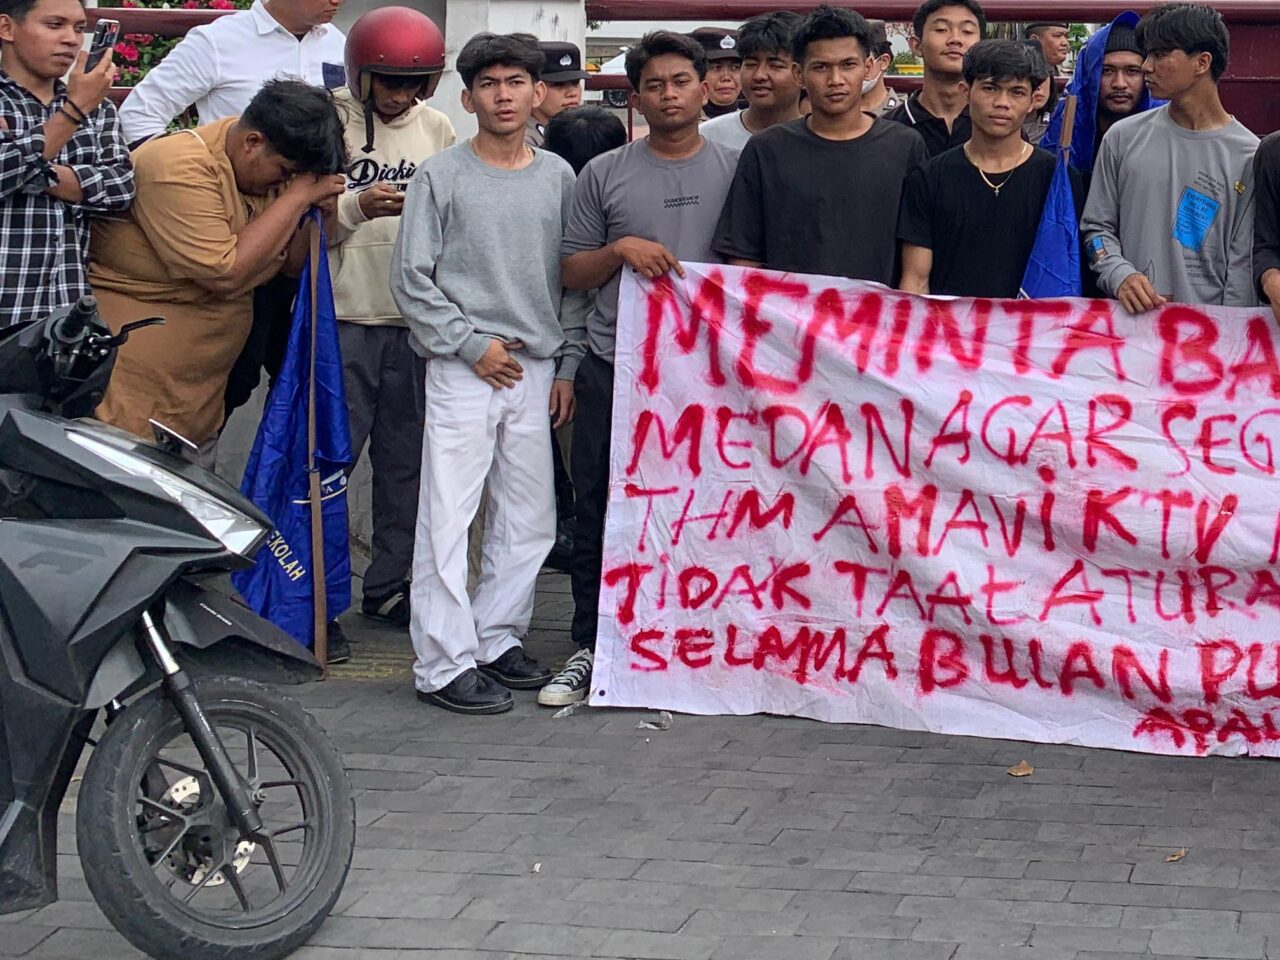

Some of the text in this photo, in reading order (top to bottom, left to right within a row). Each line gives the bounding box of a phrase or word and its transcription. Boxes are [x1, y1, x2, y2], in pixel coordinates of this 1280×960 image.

[637, 270, 1128, 395] MEMINTA
[624, 483, 794, 552] THM
[1083, 486, 1238, 564] KTV
